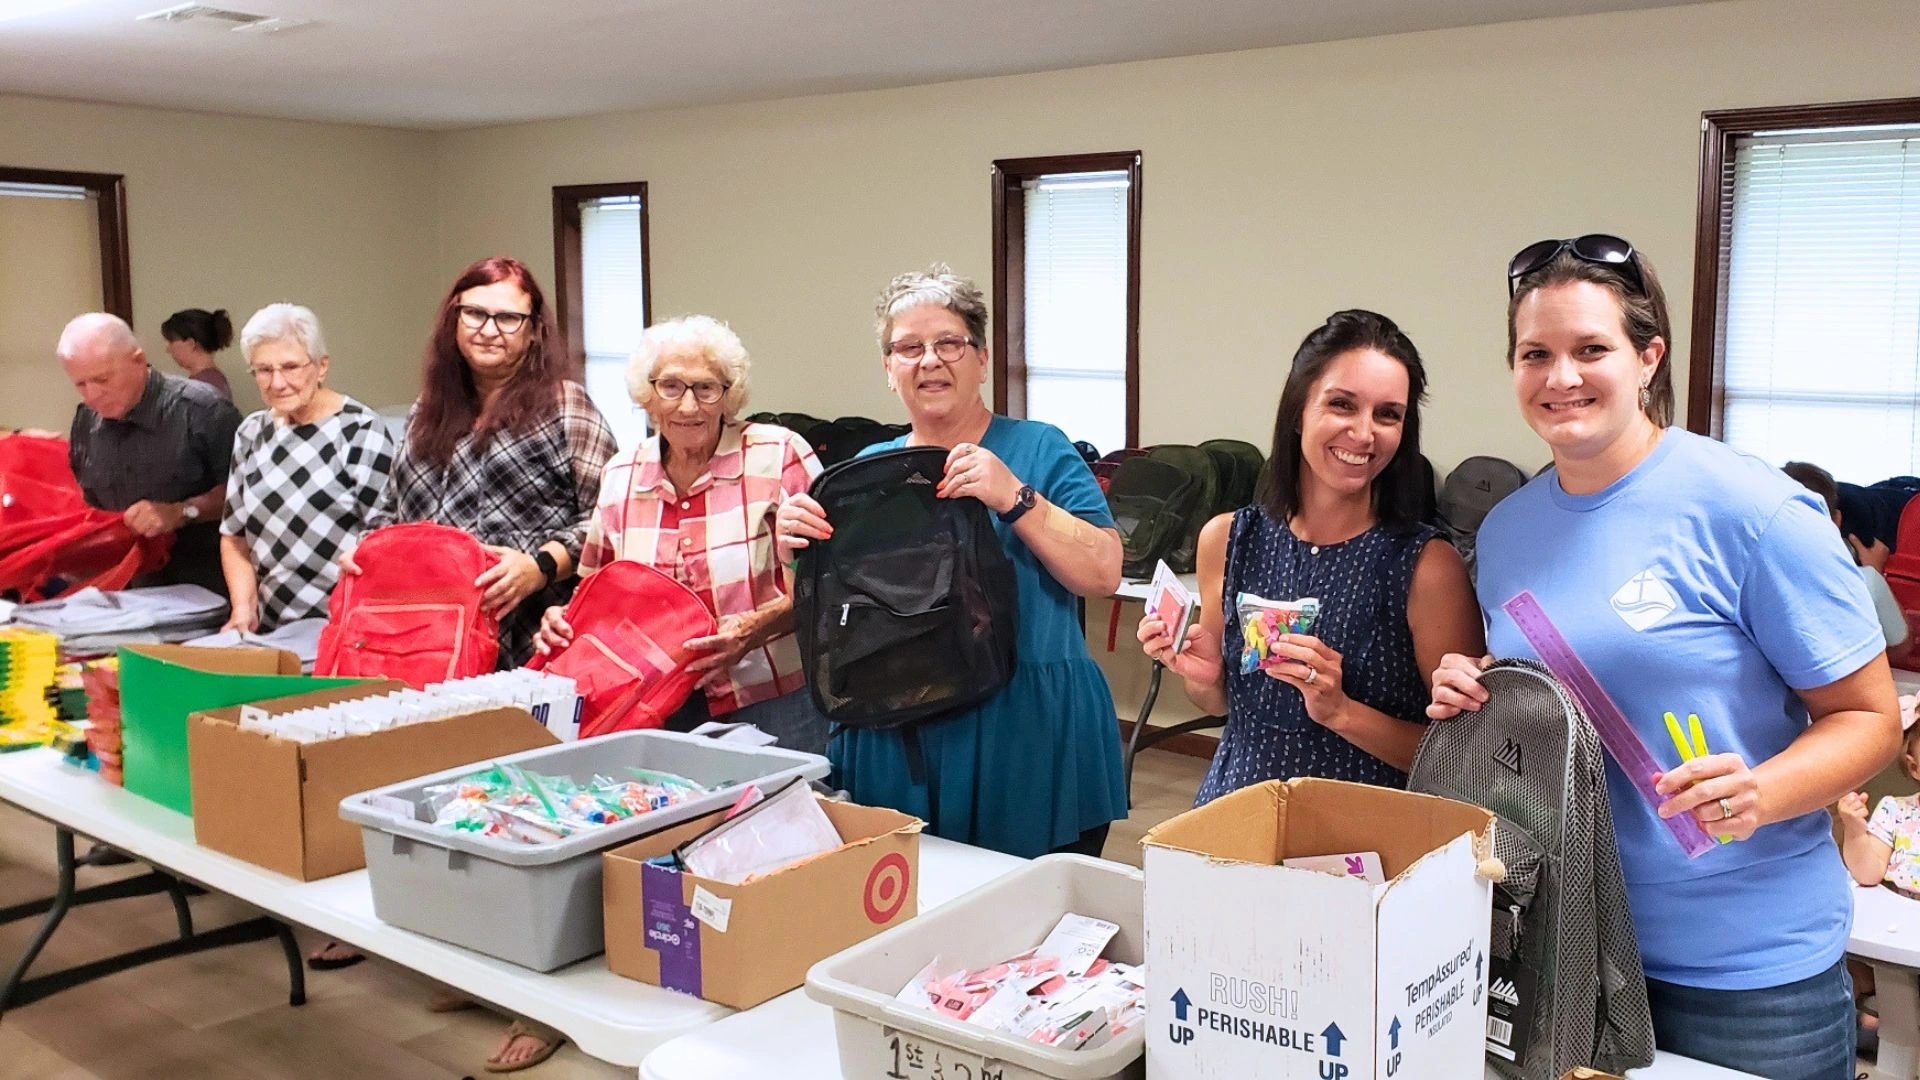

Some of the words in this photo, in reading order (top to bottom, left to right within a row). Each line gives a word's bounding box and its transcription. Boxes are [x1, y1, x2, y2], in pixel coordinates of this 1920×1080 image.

[1405, 939, 1473, 1007] TempAssured
[1210, 972, 1298, 1020] RUSH!
[1415, 978, 1465, 1034] PERISHABLE
[1472, 983, 1483, 1006] UP
[1169, 1023, 1194, 1046] UP
[1198, 1008, 1314, 1053] PERISHABLE
[1319, 1059, 1349, 1080] UP
[1386, 1051, 1402, 1077] UP
